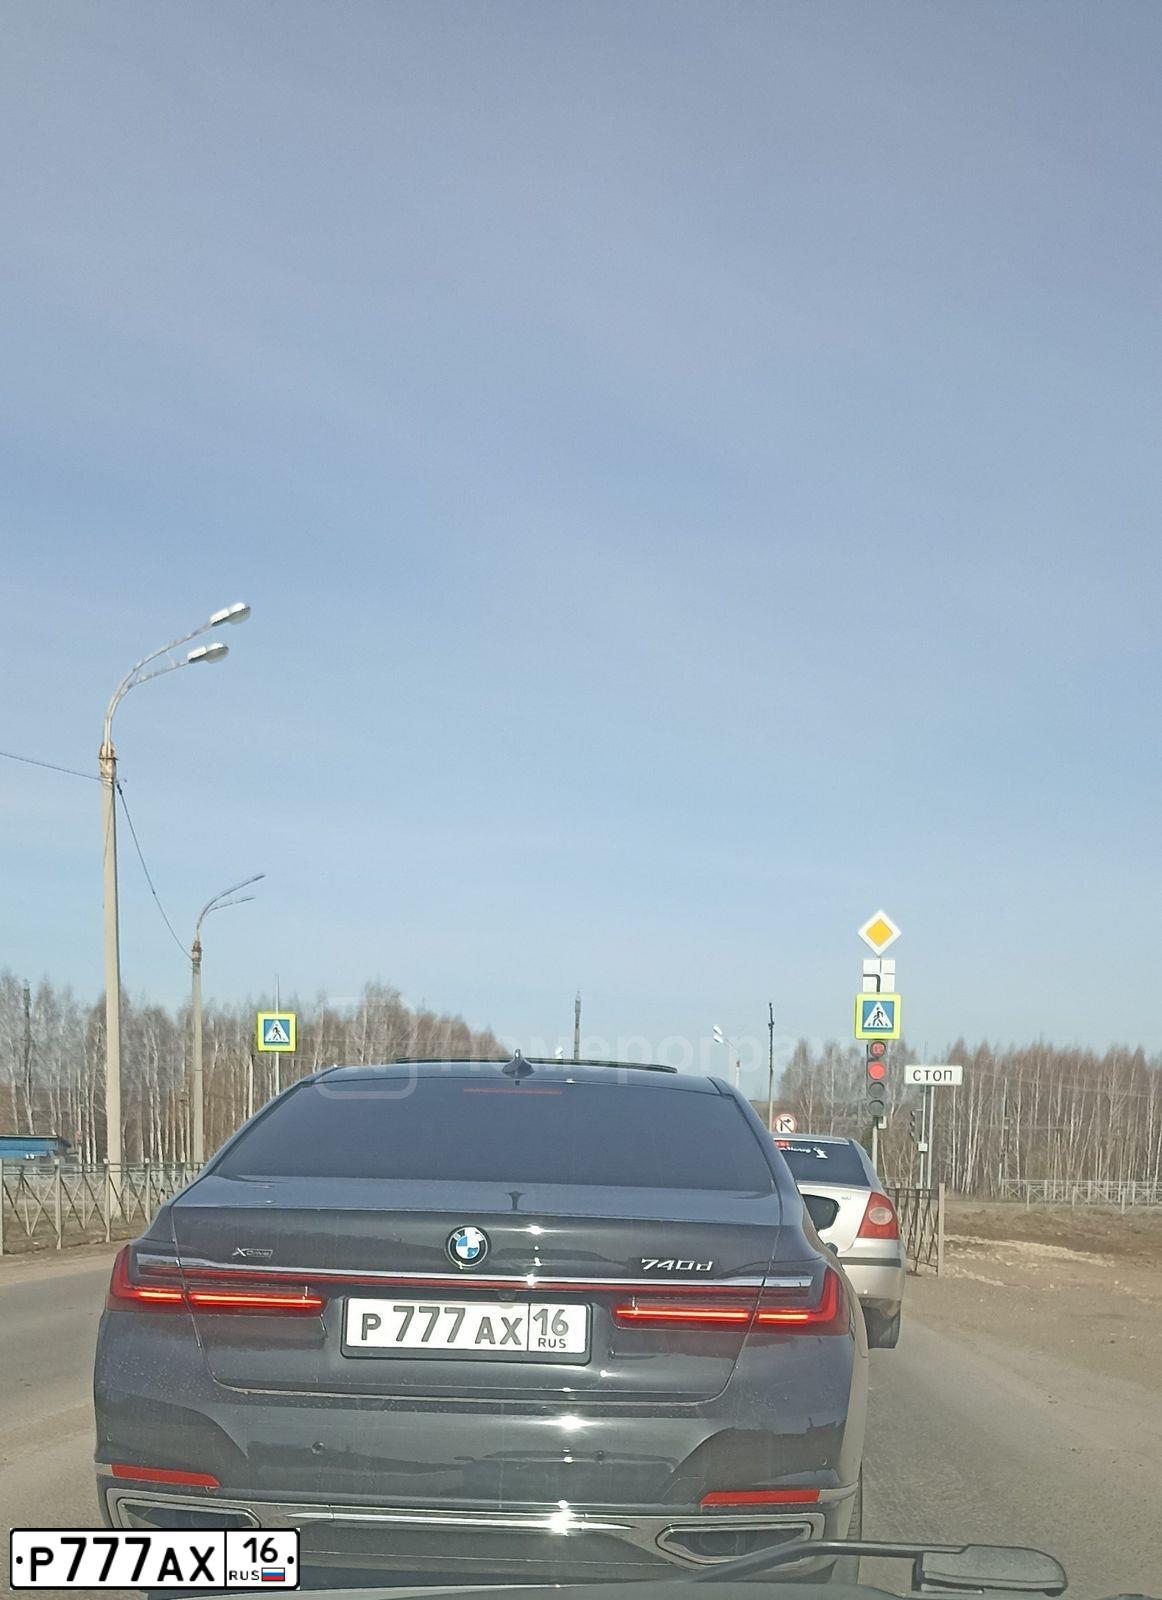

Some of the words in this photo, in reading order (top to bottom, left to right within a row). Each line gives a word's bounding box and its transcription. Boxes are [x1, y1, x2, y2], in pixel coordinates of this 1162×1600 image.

[913, 1070, 952, 1081] СТОП
[641, 1258, 713, 1271] 740d
[533, 1308, 569, 1336] 16
[538, 1337, 566, 1348] RUS
